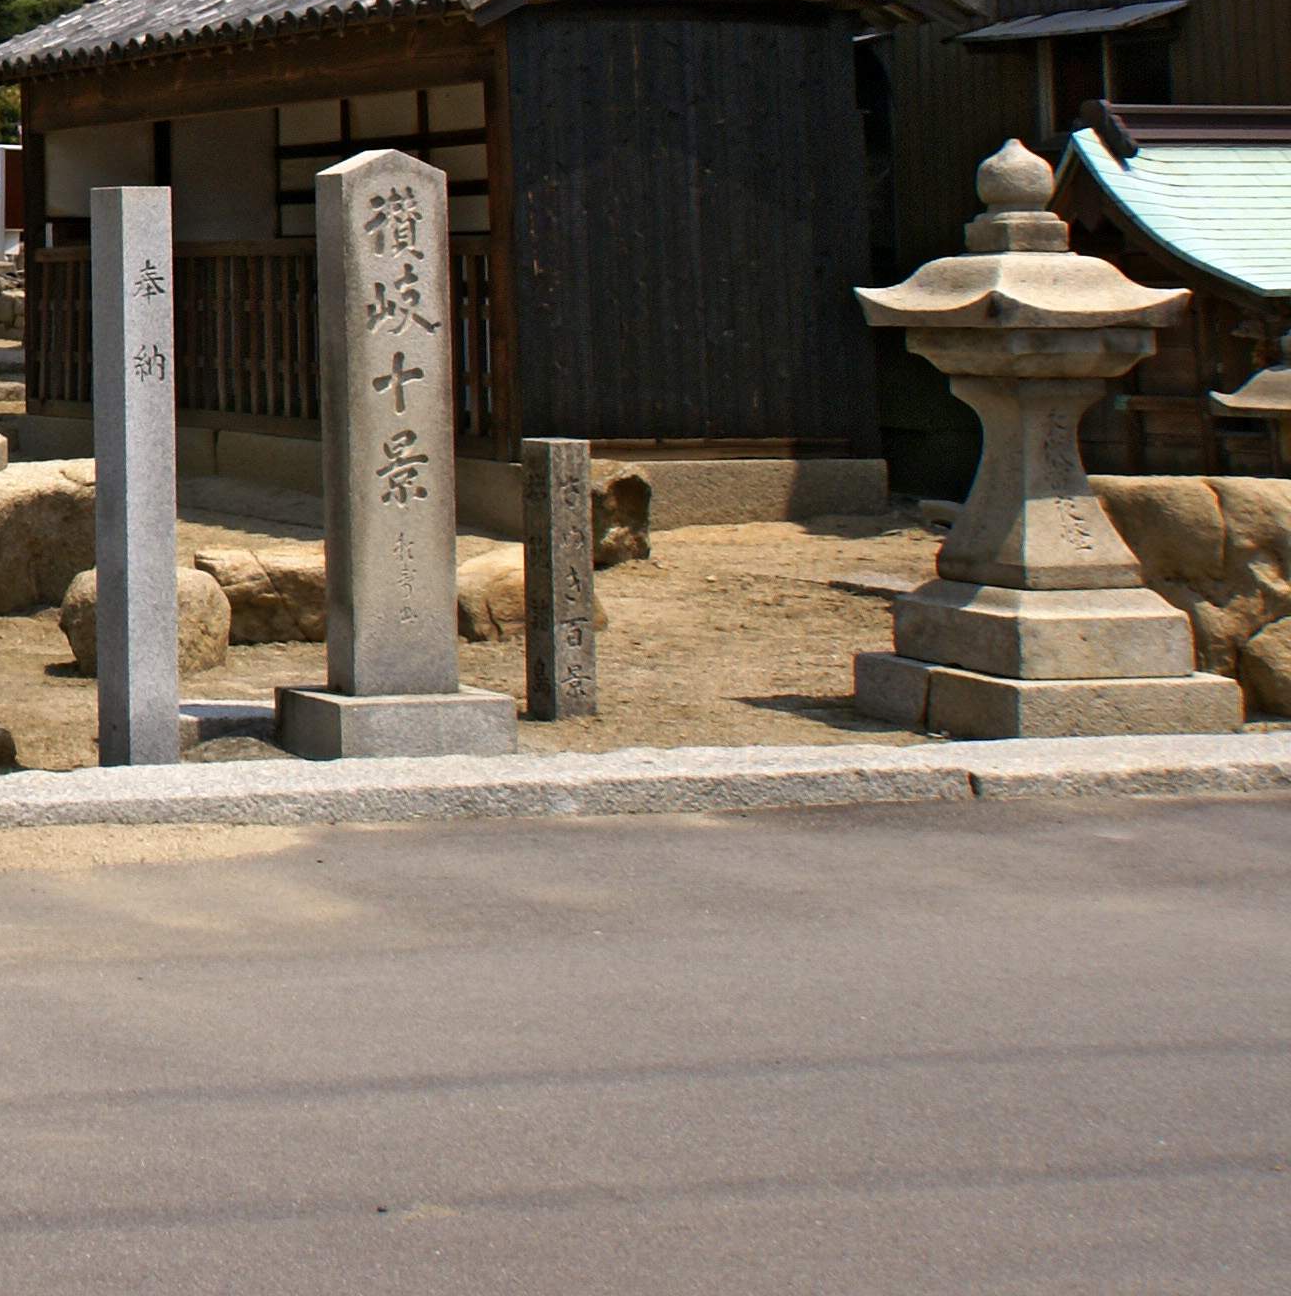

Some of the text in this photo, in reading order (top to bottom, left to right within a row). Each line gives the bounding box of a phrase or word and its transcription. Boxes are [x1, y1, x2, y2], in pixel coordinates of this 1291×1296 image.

[133, 259, 166, 383] 奉納
[559, 475, 593, 699] さぬき百景
